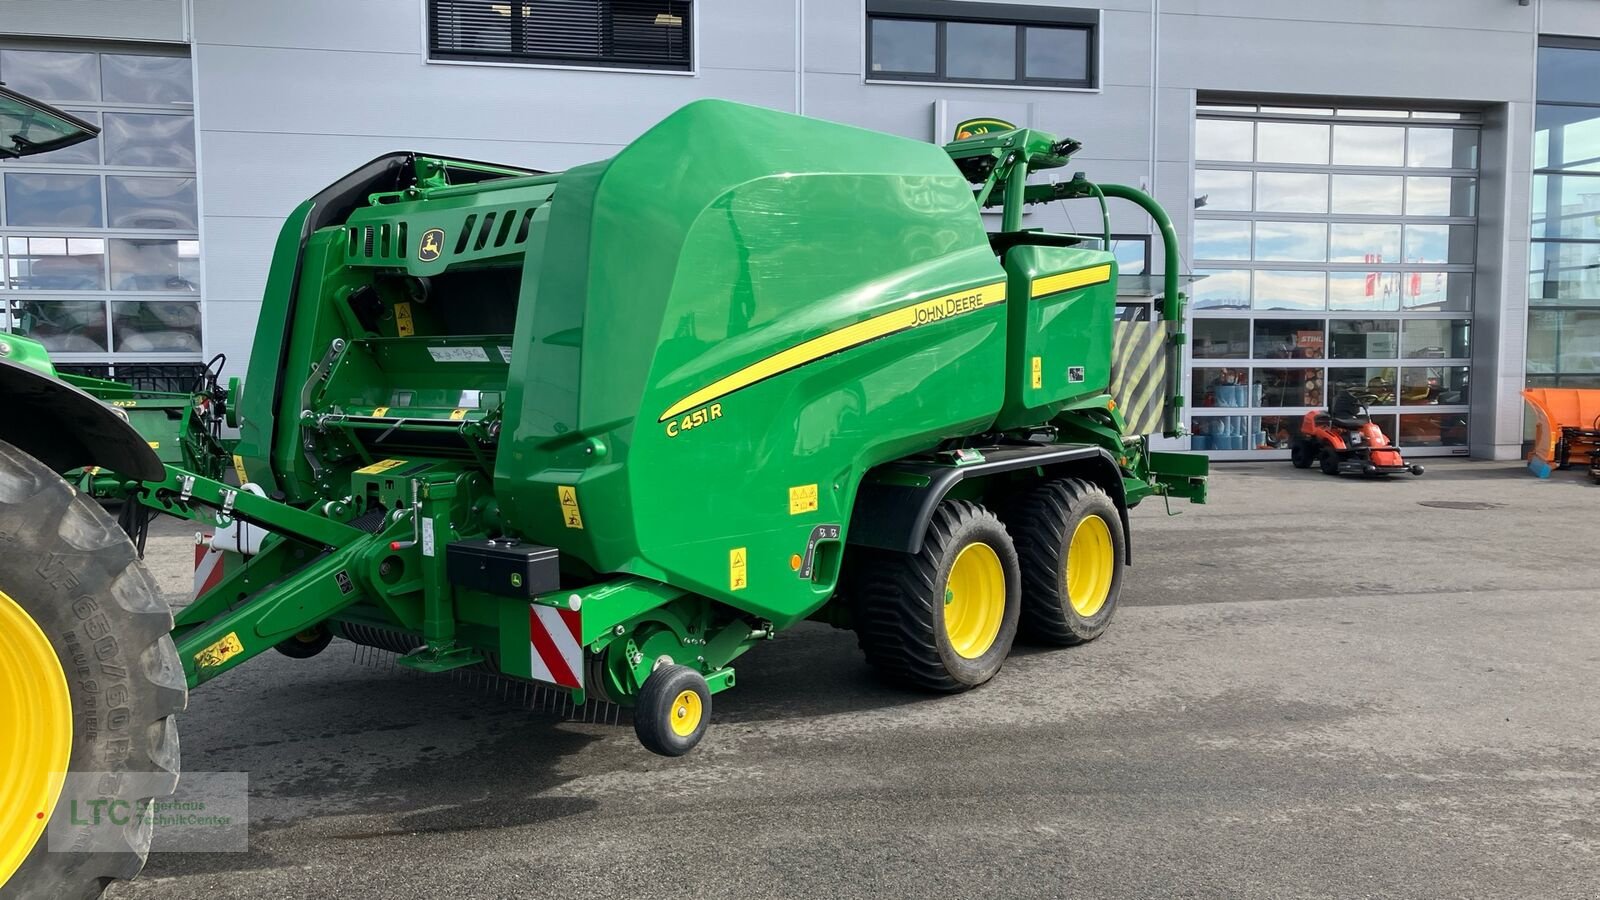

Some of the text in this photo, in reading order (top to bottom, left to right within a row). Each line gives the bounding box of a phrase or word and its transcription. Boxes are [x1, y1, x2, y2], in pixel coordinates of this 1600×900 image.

[911, 293, 983, 325] JOHN DEERE
[666, 402, 723, 437] C 451 R
